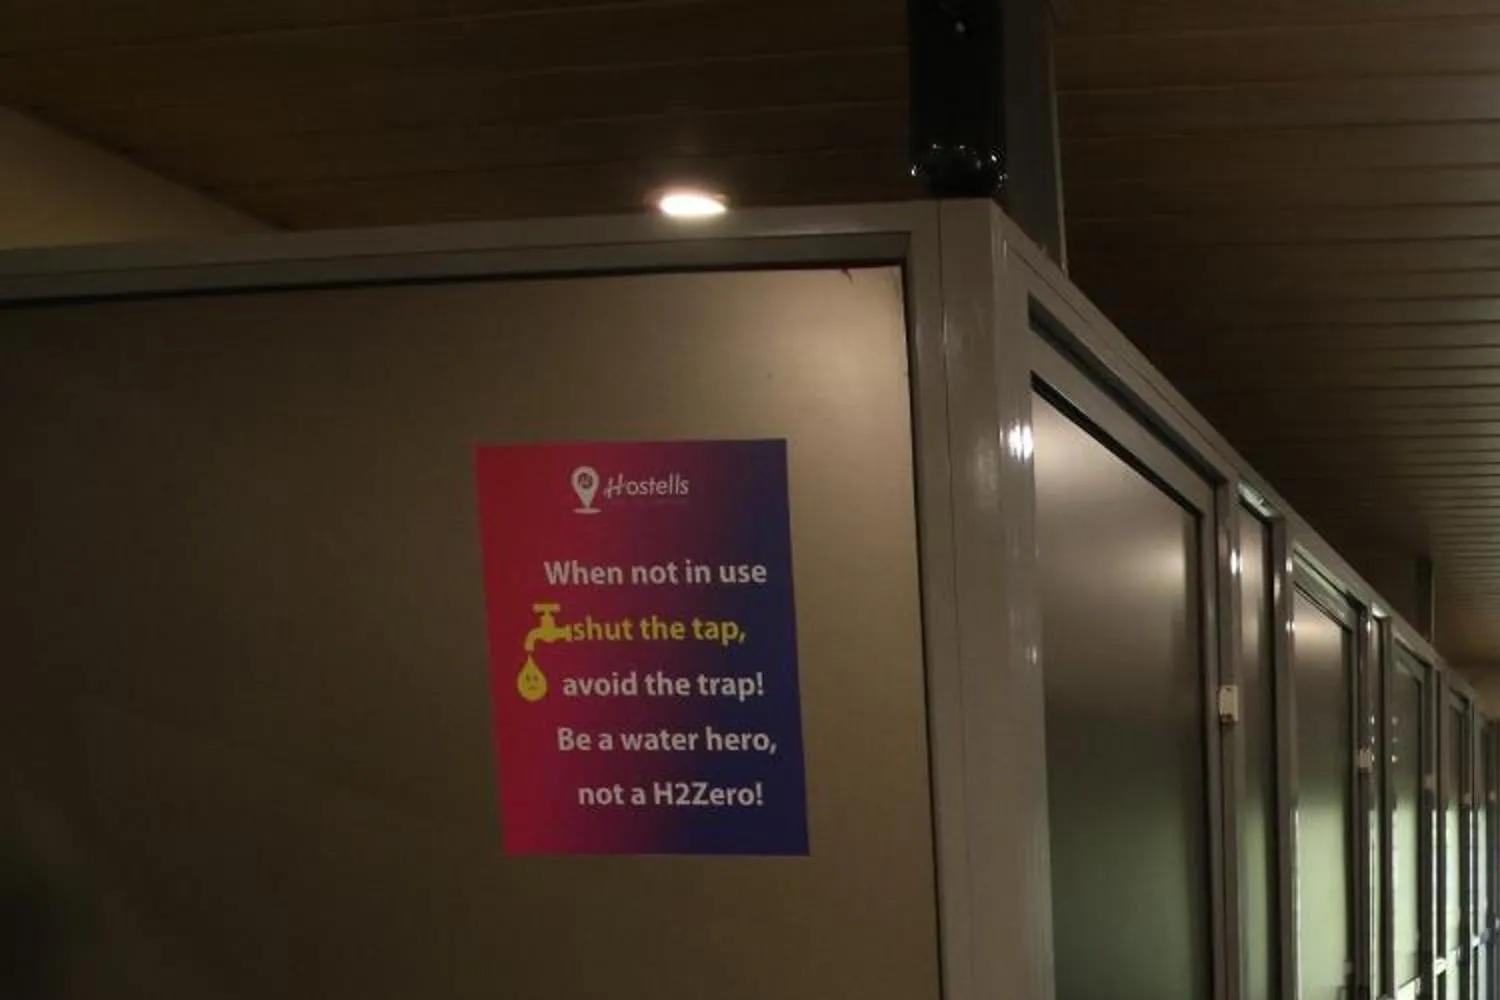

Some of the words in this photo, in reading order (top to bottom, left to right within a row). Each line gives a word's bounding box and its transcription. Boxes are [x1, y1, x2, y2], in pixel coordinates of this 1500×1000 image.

[603, 471, 690, 499] Hostells
[543, 560, 623, 585] When
[631, 562, 678, 584] not
[685, 560, 711, 584] in
[719, 563, 768, 584] use
[571, 615, 633, 641] shut
[639, 614, 686, 641] the
[691, 616, 747, 647] tap,
[562, 671, 638, 697] avoid
[643, 670, 691, 696] the
[697, 671, 764, 702] trap!
[557, 726, 592, 751] Be
[598, 732, 614, 751] a
[619, 728, 699, 751] water
[705, 725, 777, 755] hero,
[577, 783, 625, 806] not
[630, 786, 647, 806] a
[653, 780, 764, 806] H2Zero!
